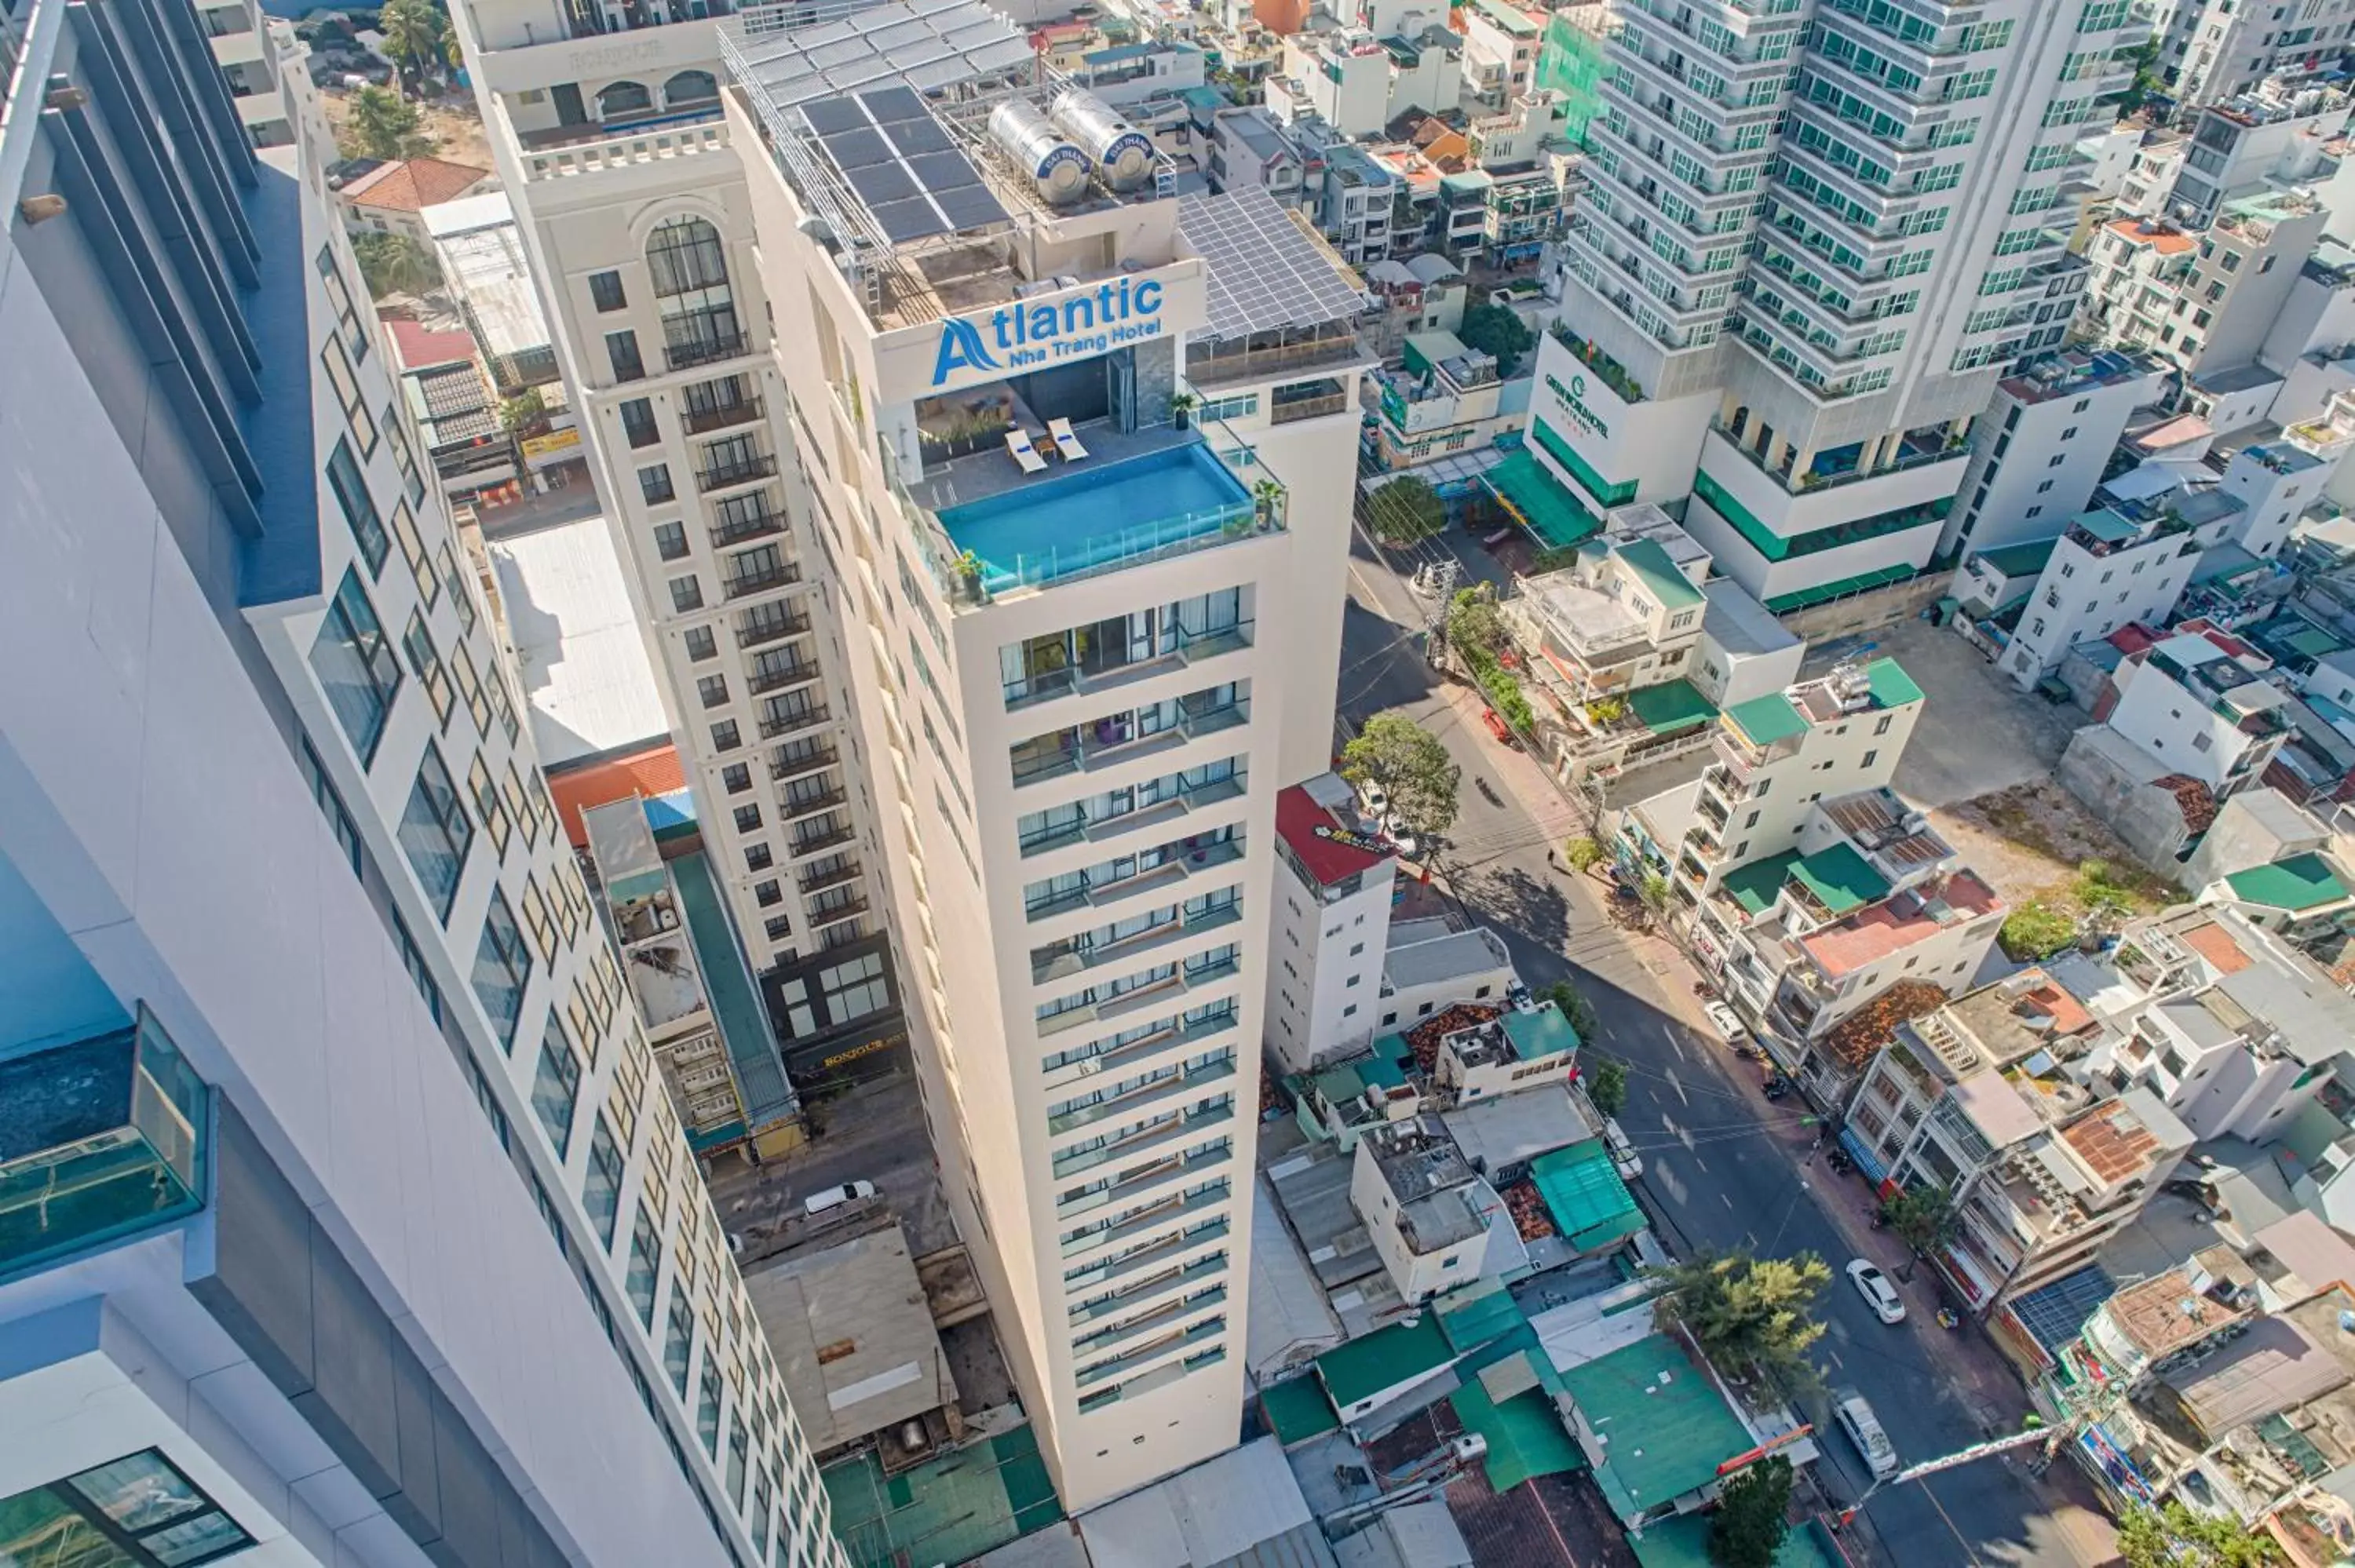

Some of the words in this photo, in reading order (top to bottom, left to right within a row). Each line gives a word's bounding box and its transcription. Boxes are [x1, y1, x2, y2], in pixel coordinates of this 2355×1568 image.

[933, 278, 1163, 386] Atlantic
[1010, 345, 1046, 368] Nha
[1051, 334, 1108, 357] Trang
[1112, 317, 1162, 344] Hotel
